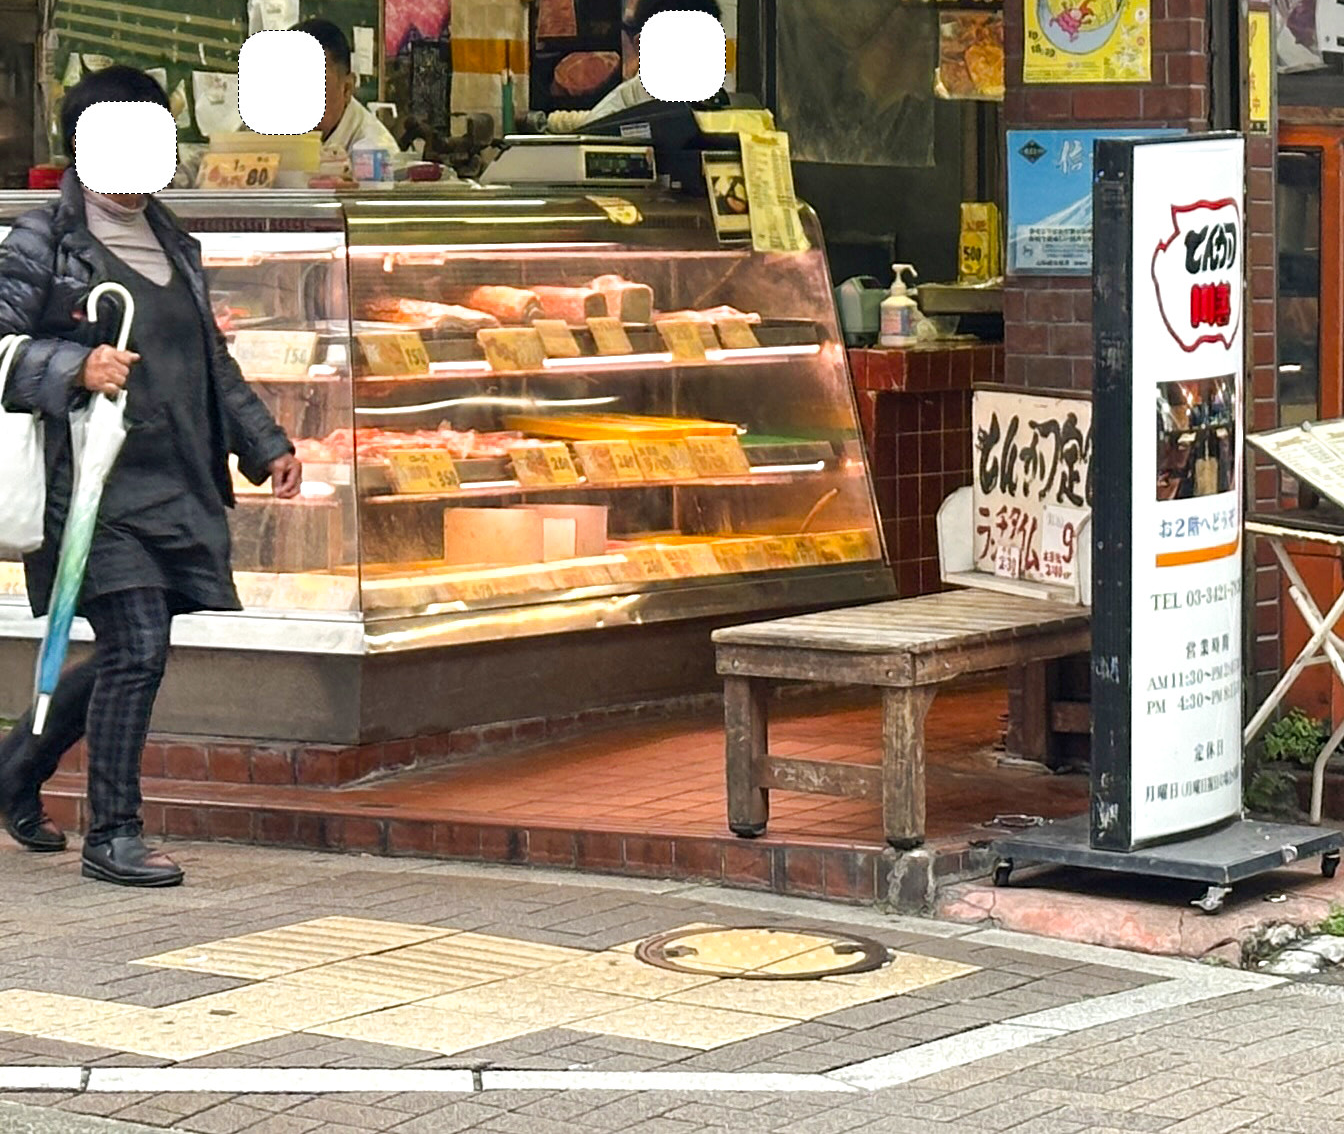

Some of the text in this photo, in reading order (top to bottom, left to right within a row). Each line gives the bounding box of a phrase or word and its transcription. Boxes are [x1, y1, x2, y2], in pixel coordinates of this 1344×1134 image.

[1184, 222, 1237, 274] とんかつ
[975, 412, 1092, 508] とんかつ定
[1158, 509, 1235, 539] お2階へどうぞ
[1150, 592, 1183, 611] TEL
[1147, 699, 1166, 715] PM
[1193, 739, 1223, 763] 定休日
